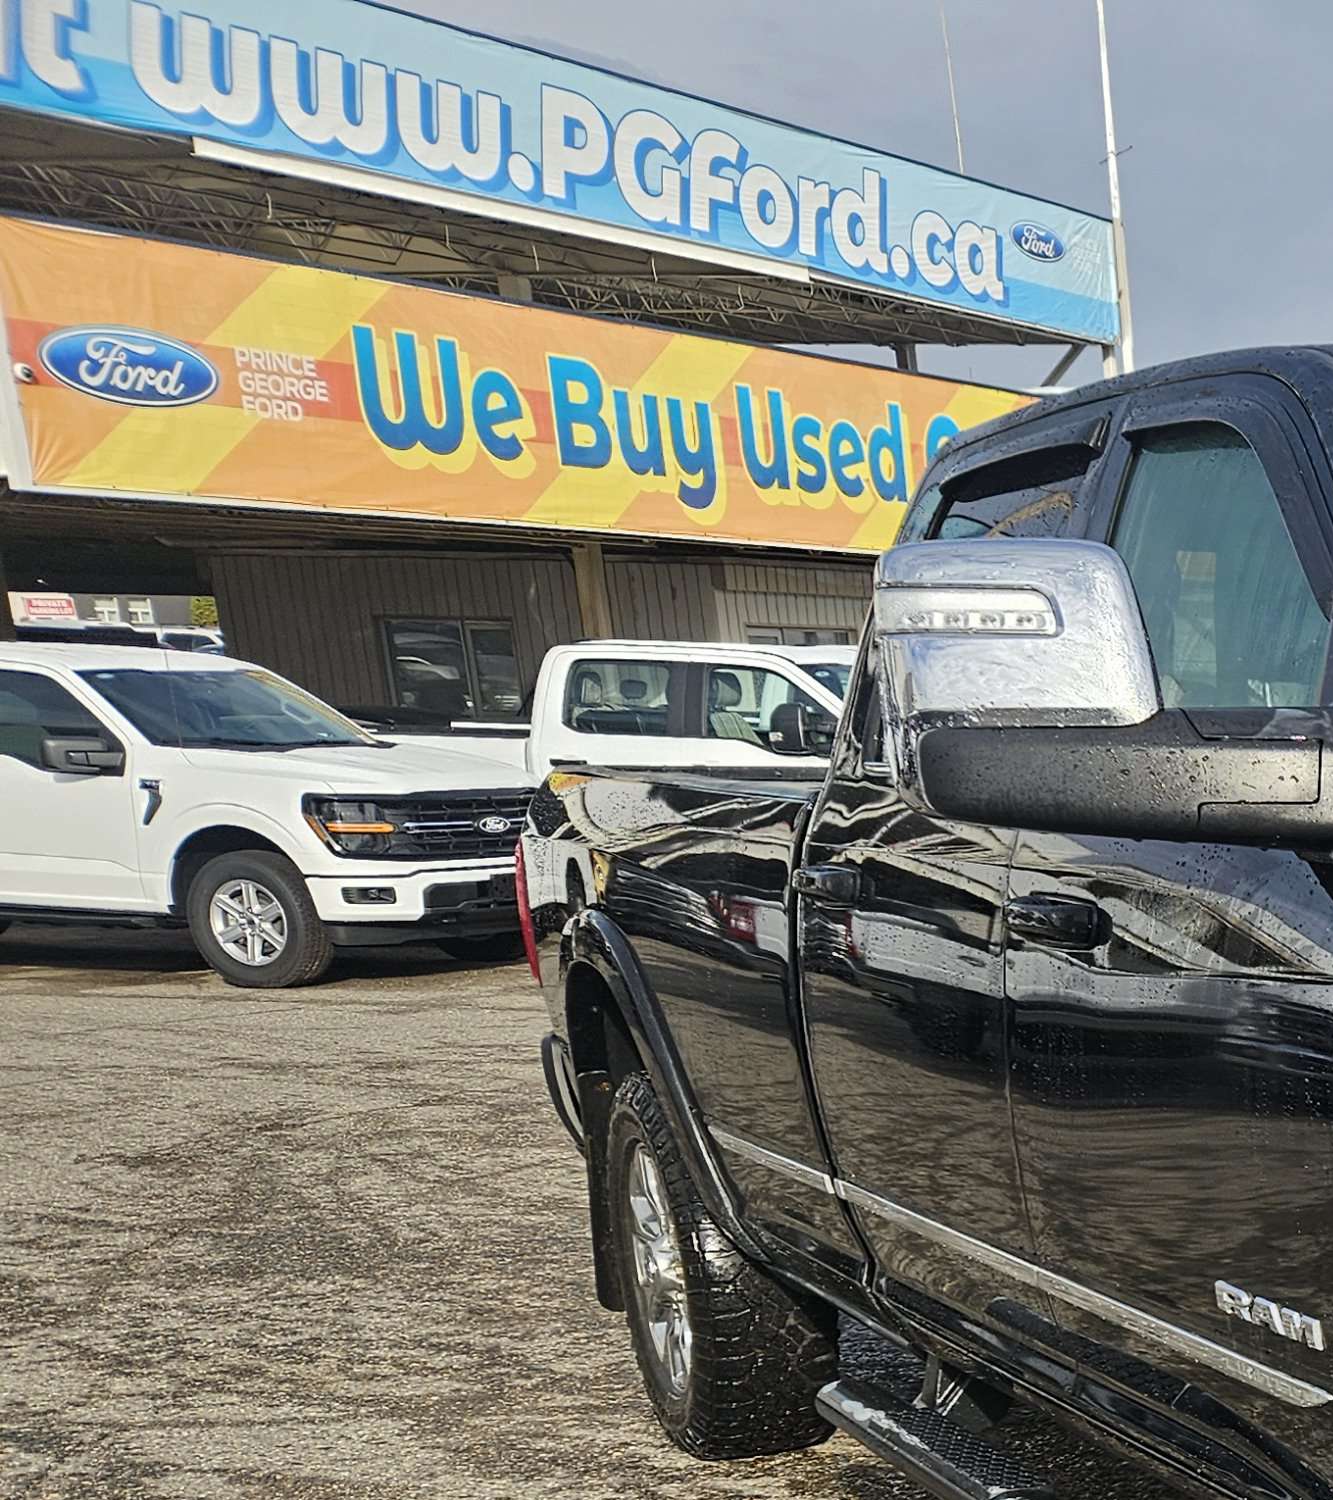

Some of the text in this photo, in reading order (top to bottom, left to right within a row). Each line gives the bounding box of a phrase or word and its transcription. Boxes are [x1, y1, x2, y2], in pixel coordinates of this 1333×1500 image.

[130, 0, 1005, 302] www.PGford.ca
[1021, 225, 1055, 258] Ford
[78, 335, 185, 396] Ford
[234, 347, 317, 377] PRINCE
[238, 371, 329, 402] GEORGE
[241, 395, 303, 421] FORD
[350, 324, 908, 510] We Buy Used
[1214, 1280, 1325, 1352] RAM
